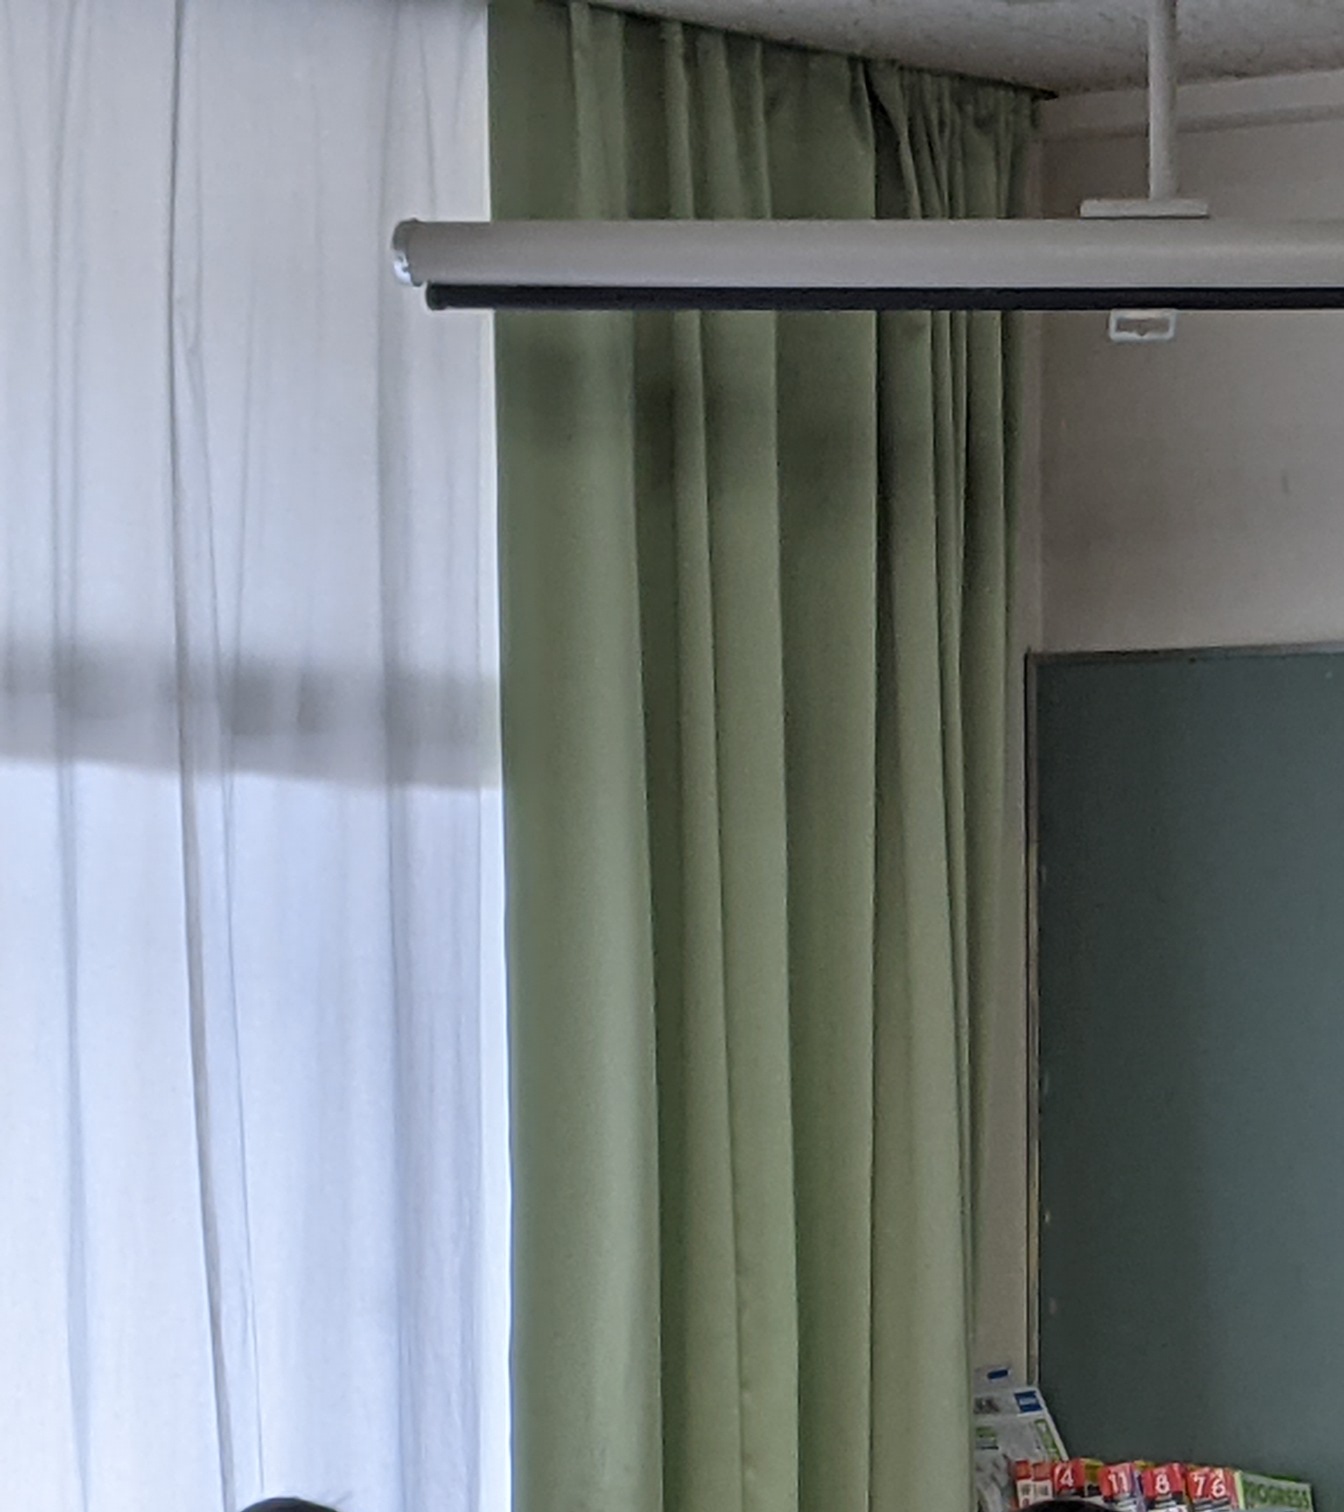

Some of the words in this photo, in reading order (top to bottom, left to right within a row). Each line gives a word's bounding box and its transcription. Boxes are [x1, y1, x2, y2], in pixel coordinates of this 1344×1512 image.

[1060, 1468, 1074, 1487] 4
[1155, 1473, 1170, 1494] 8
[1211, 1478, 1226, 1499] 6
